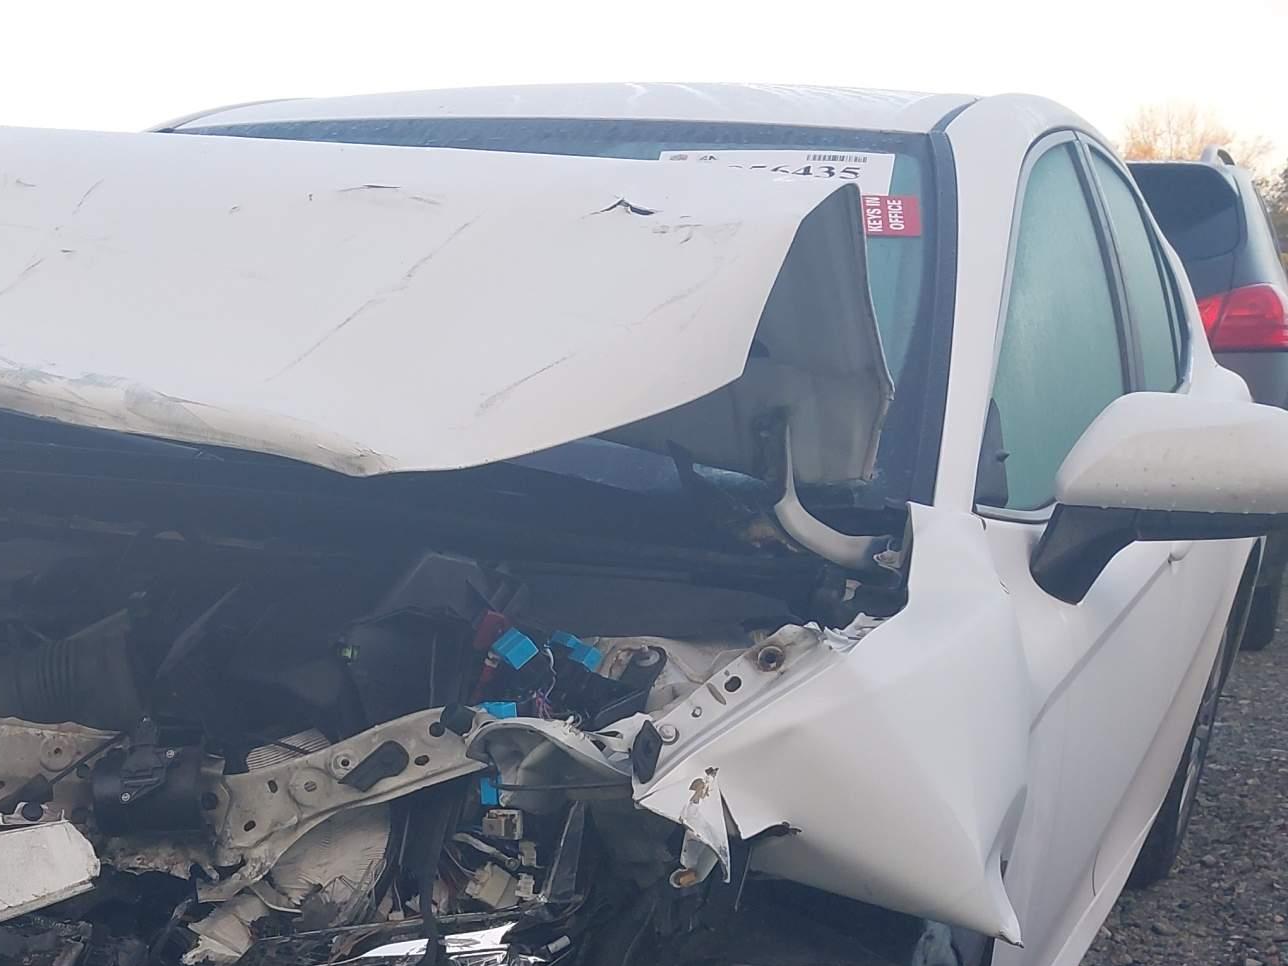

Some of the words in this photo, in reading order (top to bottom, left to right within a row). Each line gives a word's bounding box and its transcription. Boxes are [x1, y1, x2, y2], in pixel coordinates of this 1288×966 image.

[865, 197, 881, 207] IN
[867, 207, 883, 232] KEYS
[889, 199, 904, 231] OFFICE
